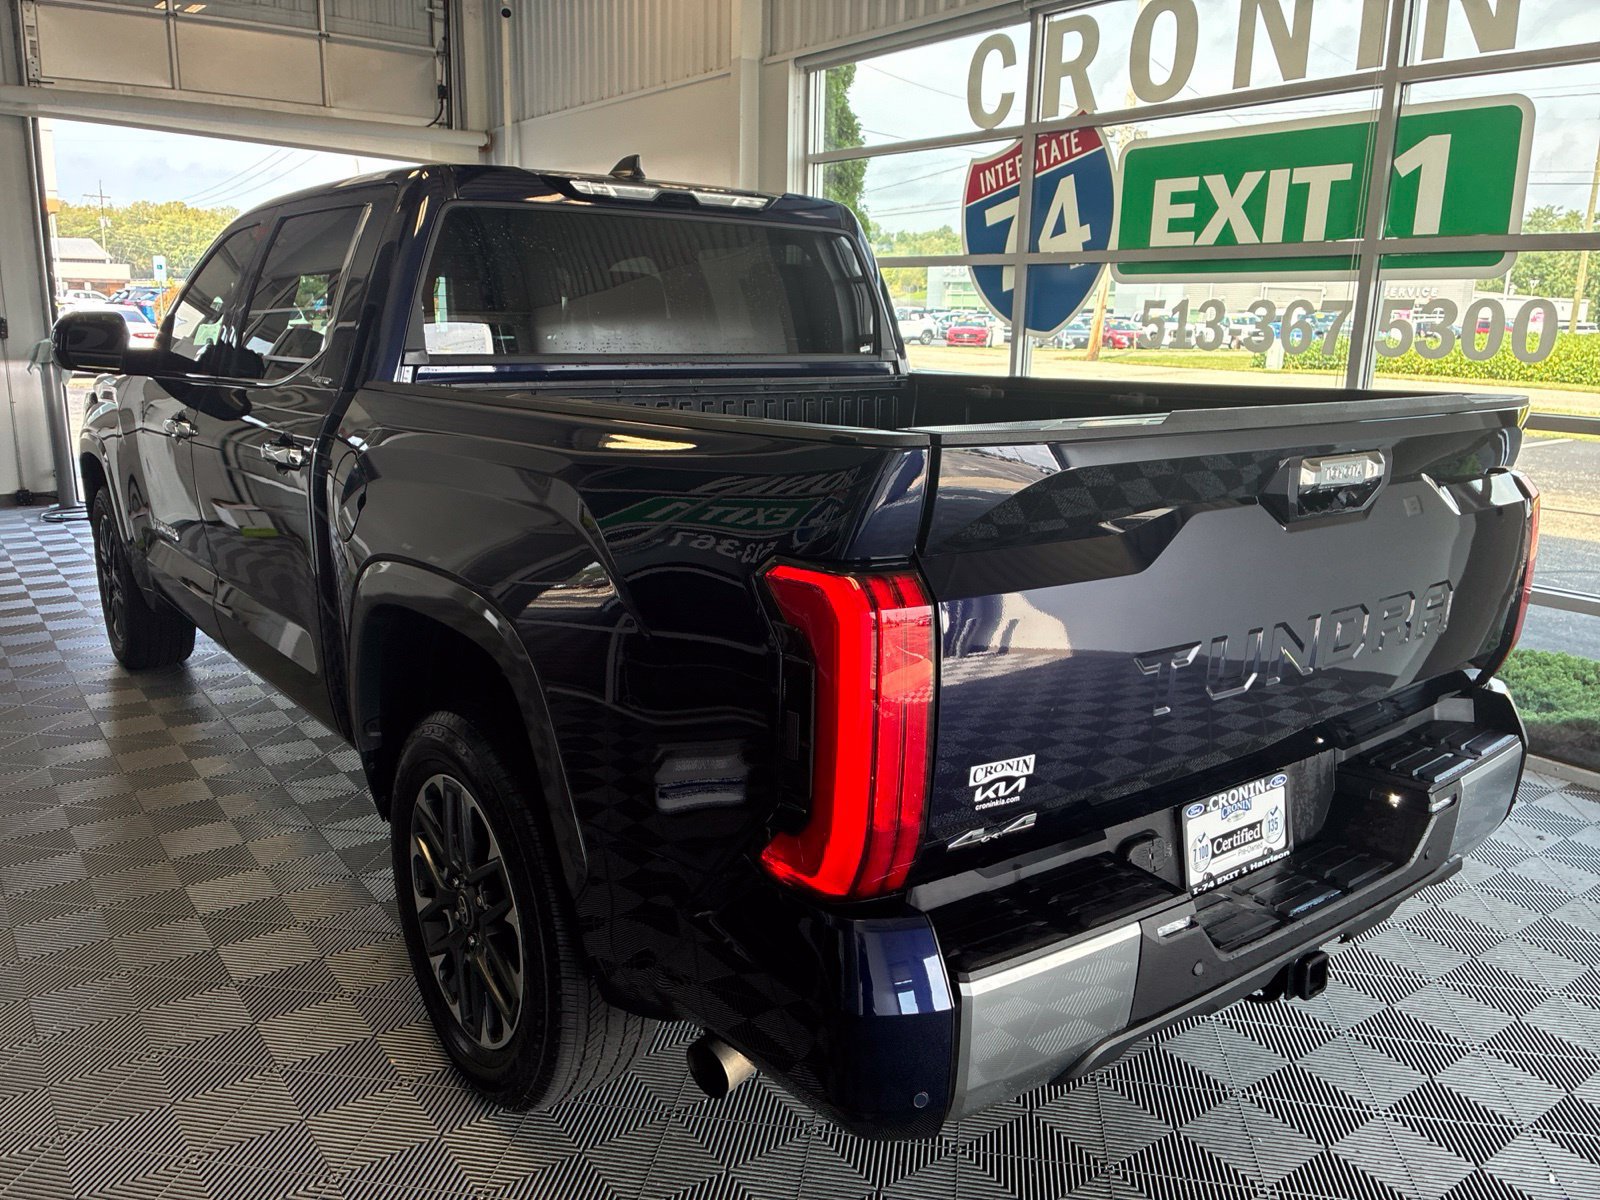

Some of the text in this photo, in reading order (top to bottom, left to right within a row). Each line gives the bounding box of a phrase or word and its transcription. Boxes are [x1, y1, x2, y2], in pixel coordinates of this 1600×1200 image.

[979, 130, 1083, 195] INTERTATE
[1149, 133, 1452, 247] EXIT 1
[985, 173, 1092, 293] 74
[1133, 578, 1455, 716] TUNDRA
[972, 757, 1032, 784] CRONIN
[974, 795, 1021, 812] croninkia.com
[1213, 823, 1262, 855] Certified
[1216, 869, 1240, 886] EXIT
[1250, 850, 1291, 871] Harrison
